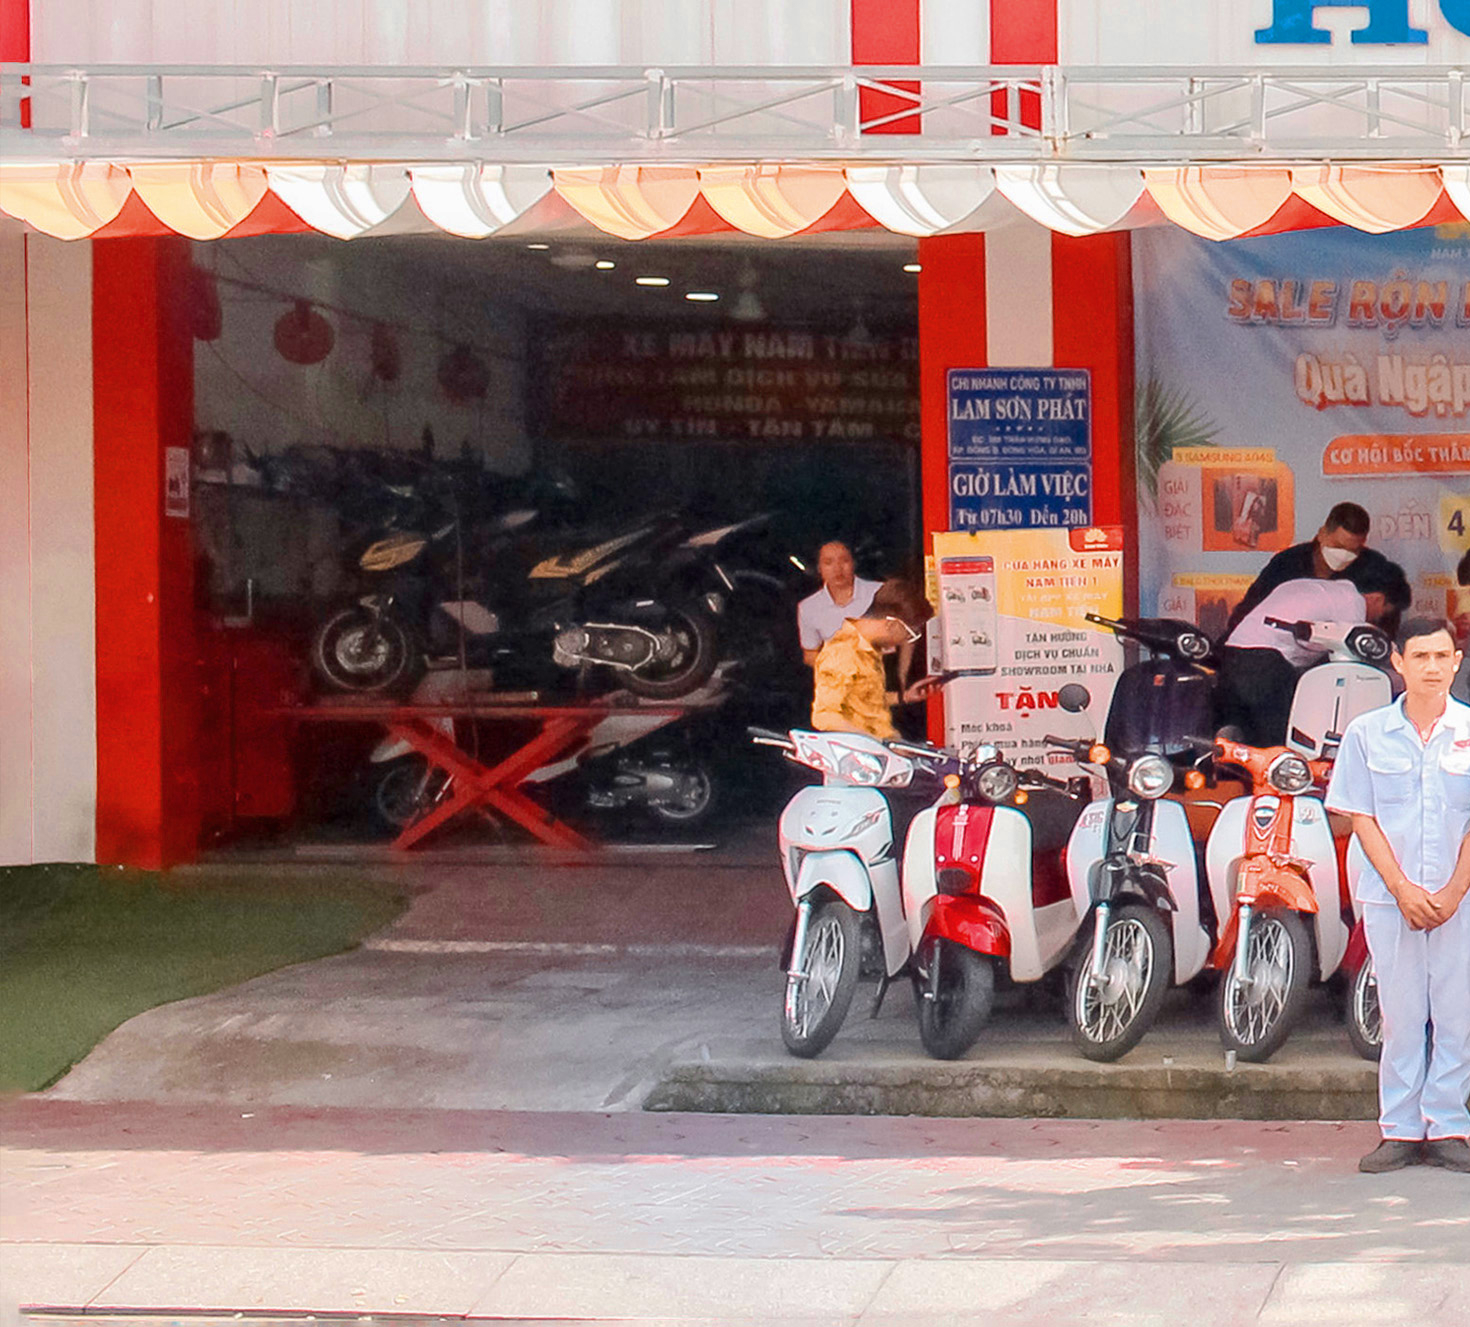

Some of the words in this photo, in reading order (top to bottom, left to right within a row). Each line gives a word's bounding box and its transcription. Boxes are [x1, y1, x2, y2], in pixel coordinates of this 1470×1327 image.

[1227, 276, 1338, 328] SALE
[1348, 269, 1450, 340] RỘN
[1295, 352, 1371, 410] Quà
[952, 398, 991, 420] LAM
[995, 395, 1033, 421] SƠN
[1037, 393, 1087, 420] PHÁT
[953, 468, 990, 497] GIỜ
[994, 468, 1037, 496] LÀM
[1042, 470, 1088, 503] VIỆC
[981, 508, 1023, 525] 07h30
[1062, 509, 1088, 525] 20h
[1446, 509, 1466, 537] 4
